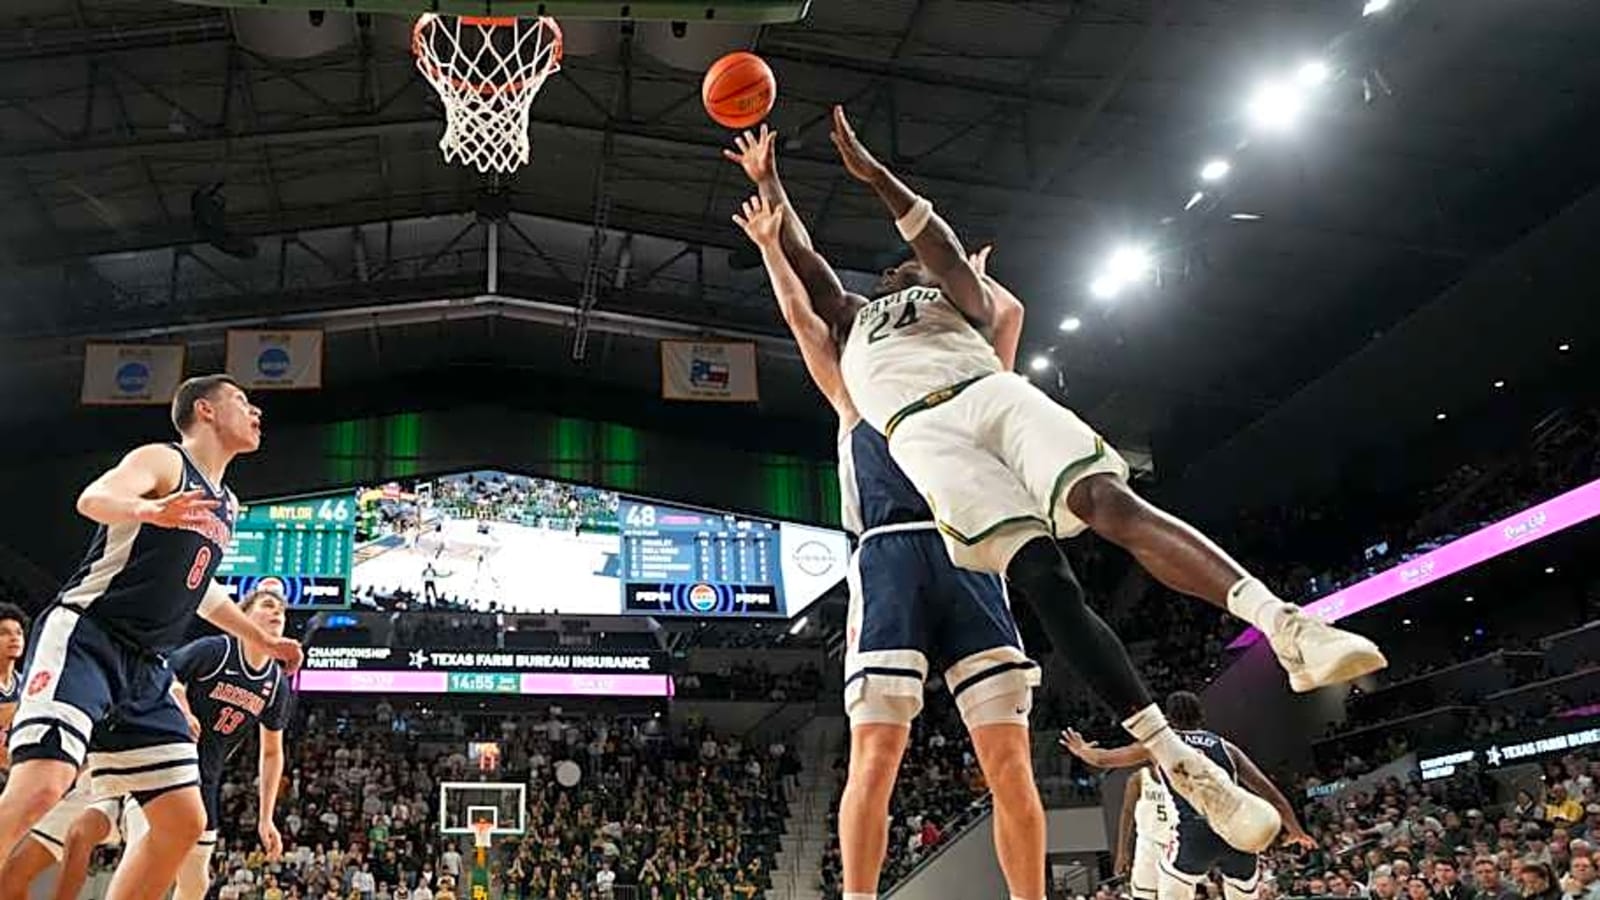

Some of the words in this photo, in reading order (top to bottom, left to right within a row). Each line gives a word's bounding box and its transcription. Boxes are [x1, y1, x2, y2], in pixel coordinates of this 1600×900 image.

[859, 288, 939, 326] BAYLOR
[868, 301, 920, 344] 24
[269, 505, 313, 520] BAYLOR
[317, 499, 349, 521] 46
[626, 505, 656, 528] 48
[186, 545, 213, 591] 8
[306, 647, 391, 660] CHAMPIONSHIP
[306, 657, 358, 669] PARTNER
[430, 652, 475, 667] TEXAS
[476, 654, 514, 667] FARM
[516, 654, 570, 668] BUREAU
[572, 656, 651, 670] INSURANCE
[212, 705, 246, 735] 13
[1500, 742, 1535, 760] TEXAS
[1568, 728, 1600, 748] BURE
[1156, 804, 1168, 822] 5
